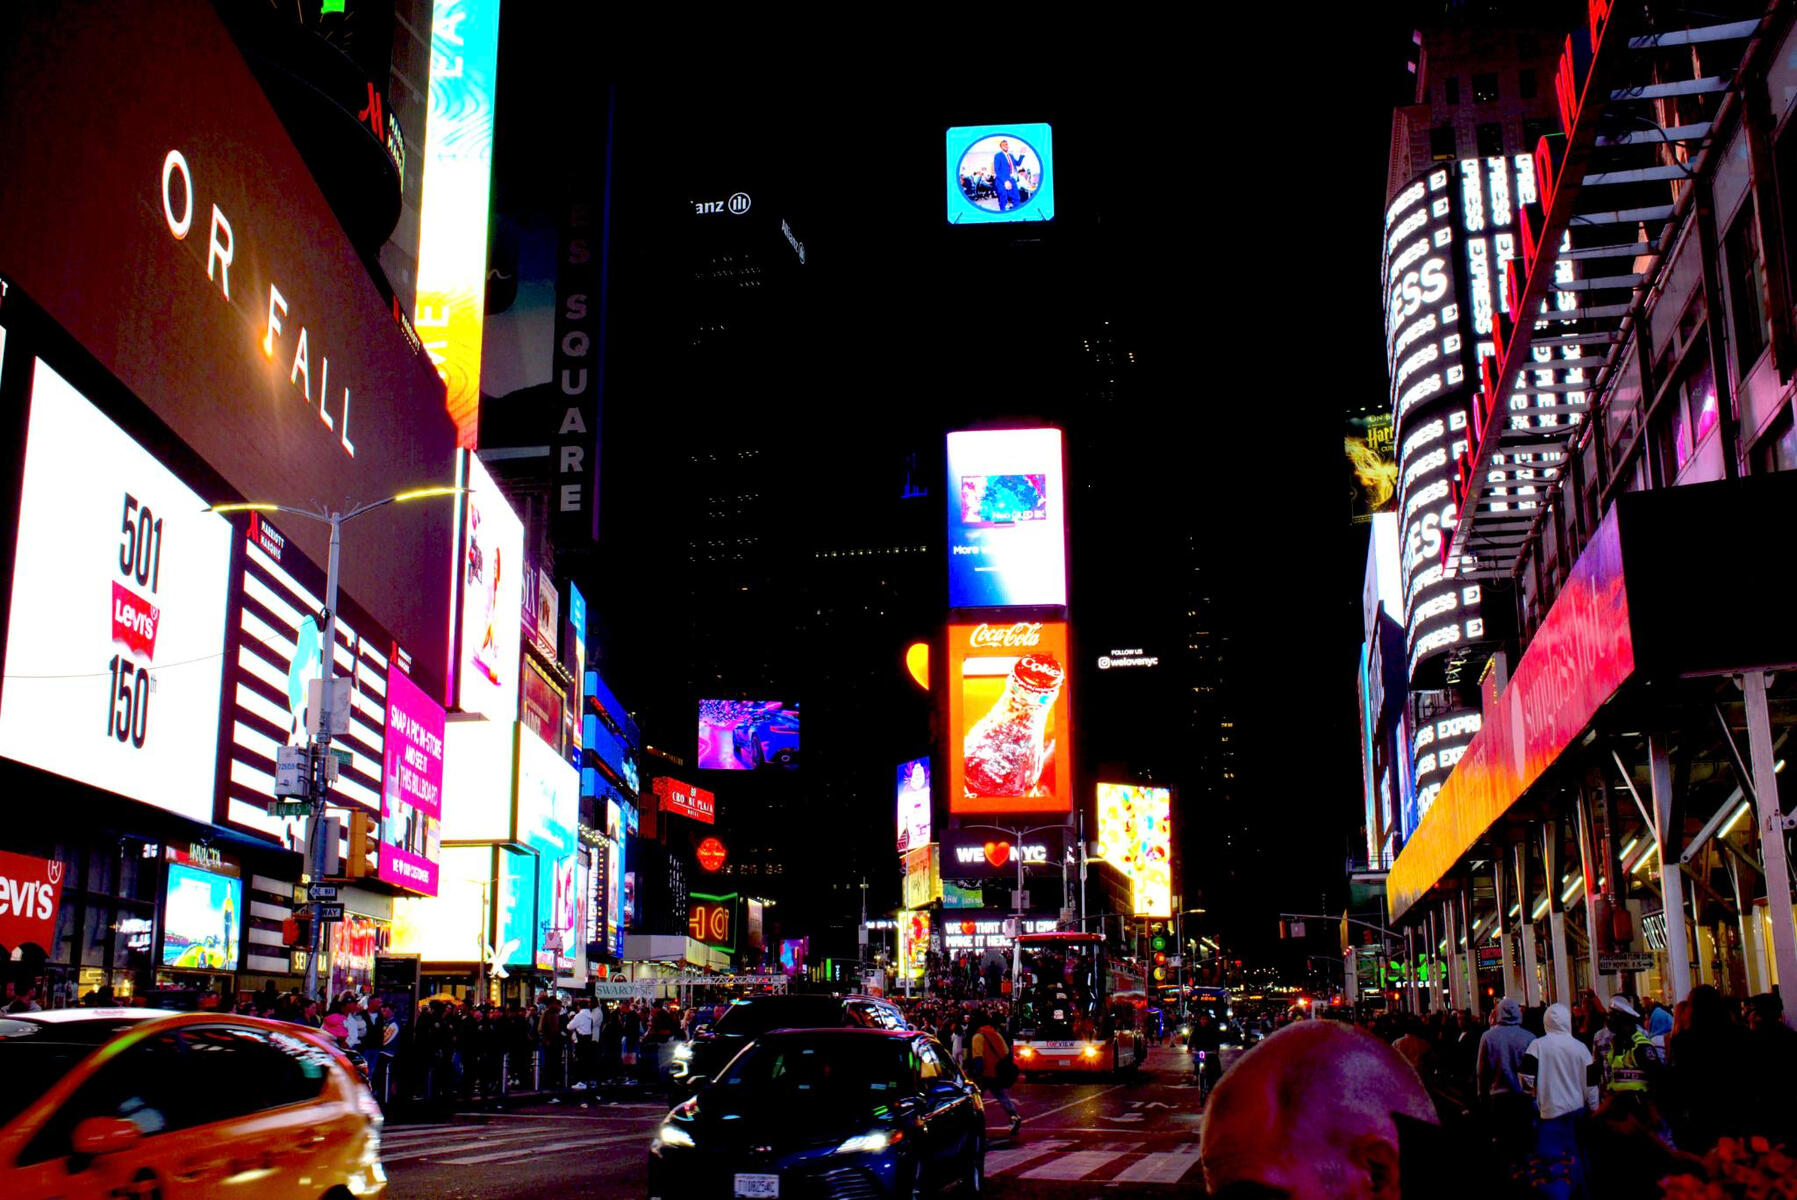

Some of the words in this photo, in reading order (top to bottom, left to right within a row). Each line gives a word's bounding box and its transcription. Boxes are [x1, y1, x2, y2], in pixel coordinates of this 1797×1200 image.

[262, 282, 355, 458] FALL
[560, 293, 591, 512] SQUARE
[119, 491, 163, 595] 501
[1110, 656, 1158, 668] welovenyc
[957, 846, 985, 863] WE
[1010, 845, 1046, 861] NYC
[322, 907, 338, 917] WAY
[945, 922, 962, 935] WE
